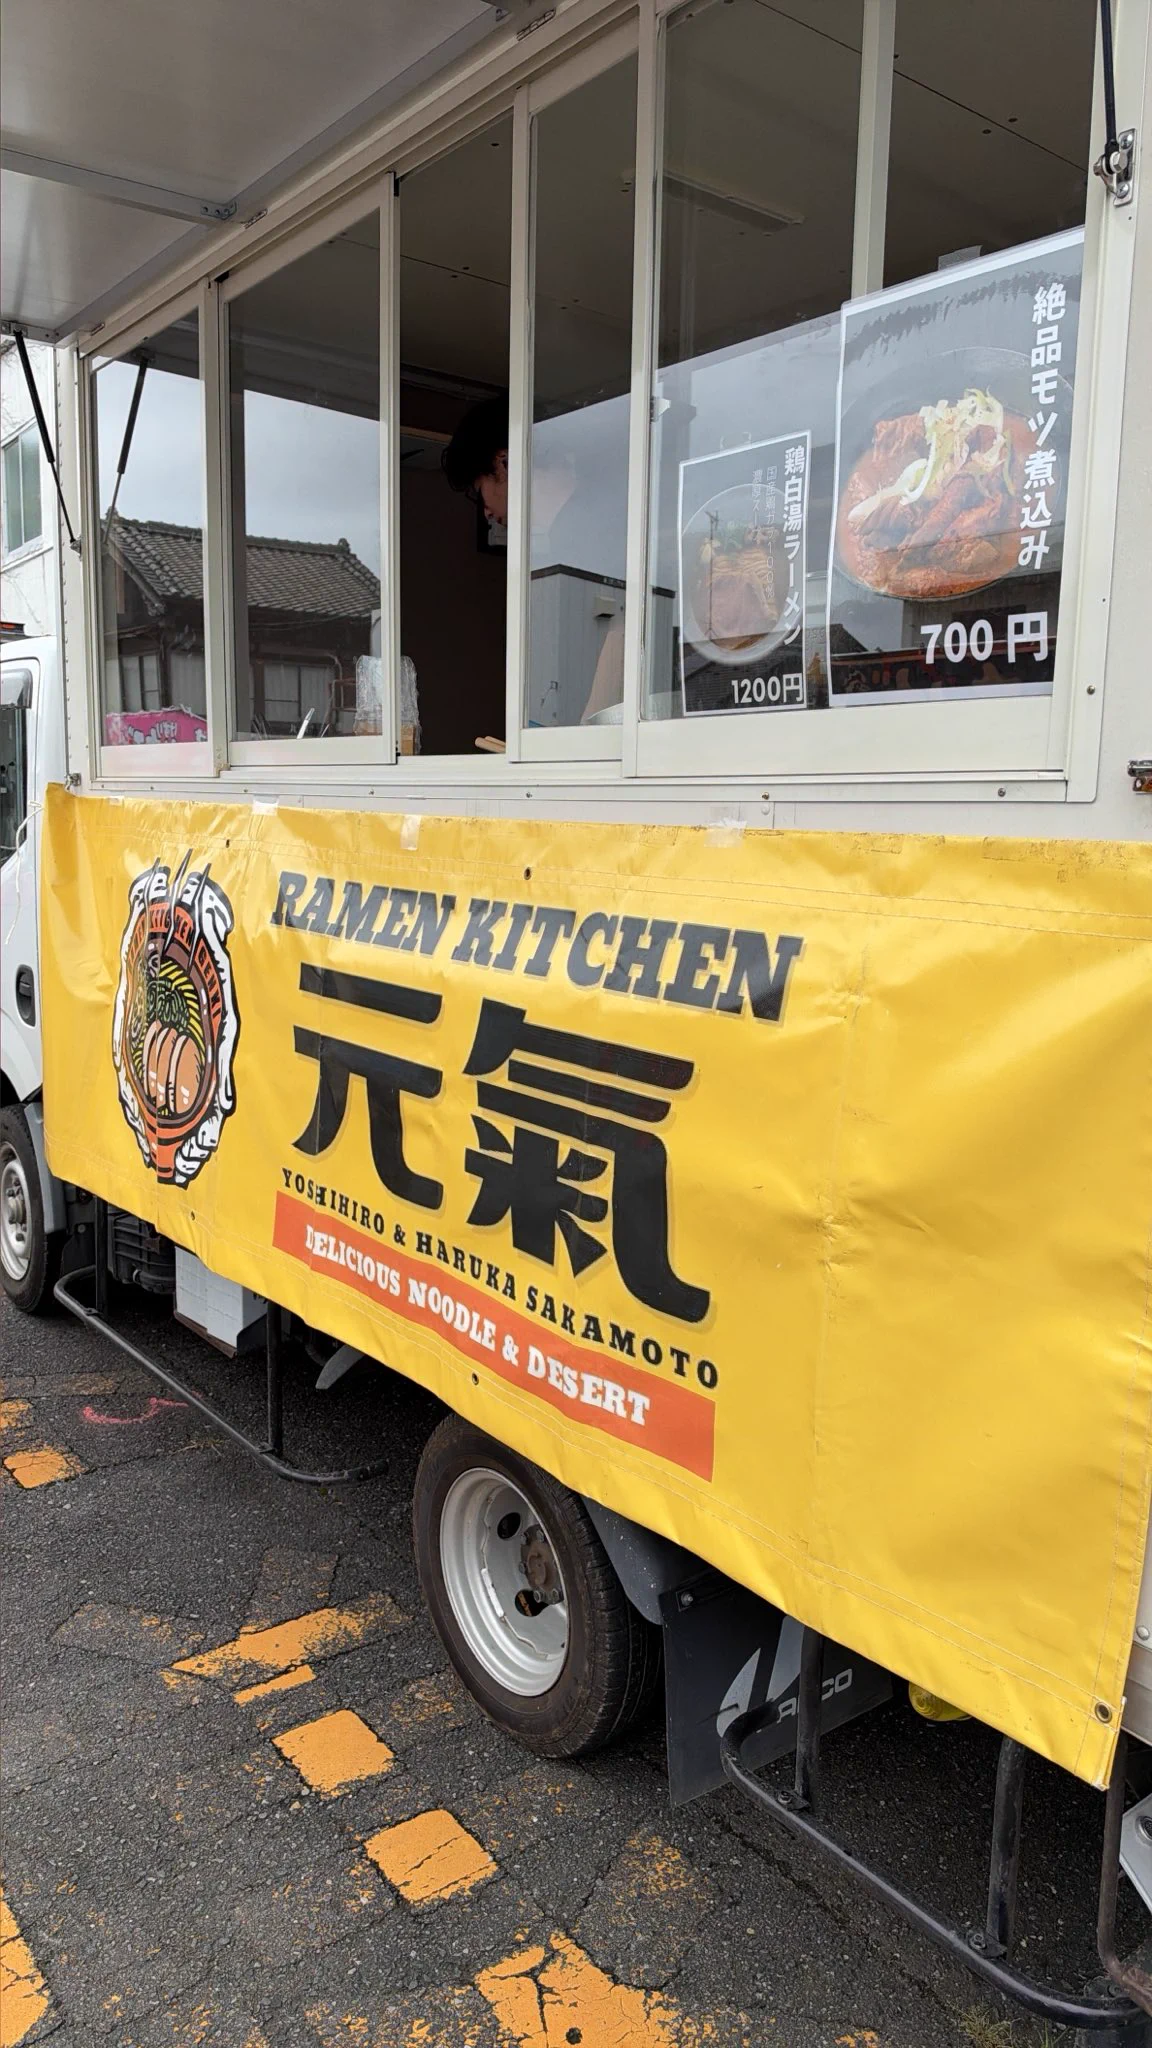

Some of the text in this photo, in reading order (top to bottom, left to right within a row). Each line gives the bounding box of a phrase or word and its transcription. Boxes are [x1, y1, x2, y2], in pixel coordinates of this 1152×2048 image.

[1018, 282, 1066, 570] 絶品モツ煮込み
[782, 445, 805, 645] 鶏白湯ラーメン
[731, 673, 803, 704] 1200円
[270, 870, 457, 955] RAMEN
[451, 897, 803, 1022] KITCHEN
[291, 962, 711, 1323] 元氣
[282, 1168, 719, 1390] YOSHIHIRO & HARUKA SAKAMOTO
[305, 1224, 650, 1426] DELICIOUS NOODLE & DESERT
